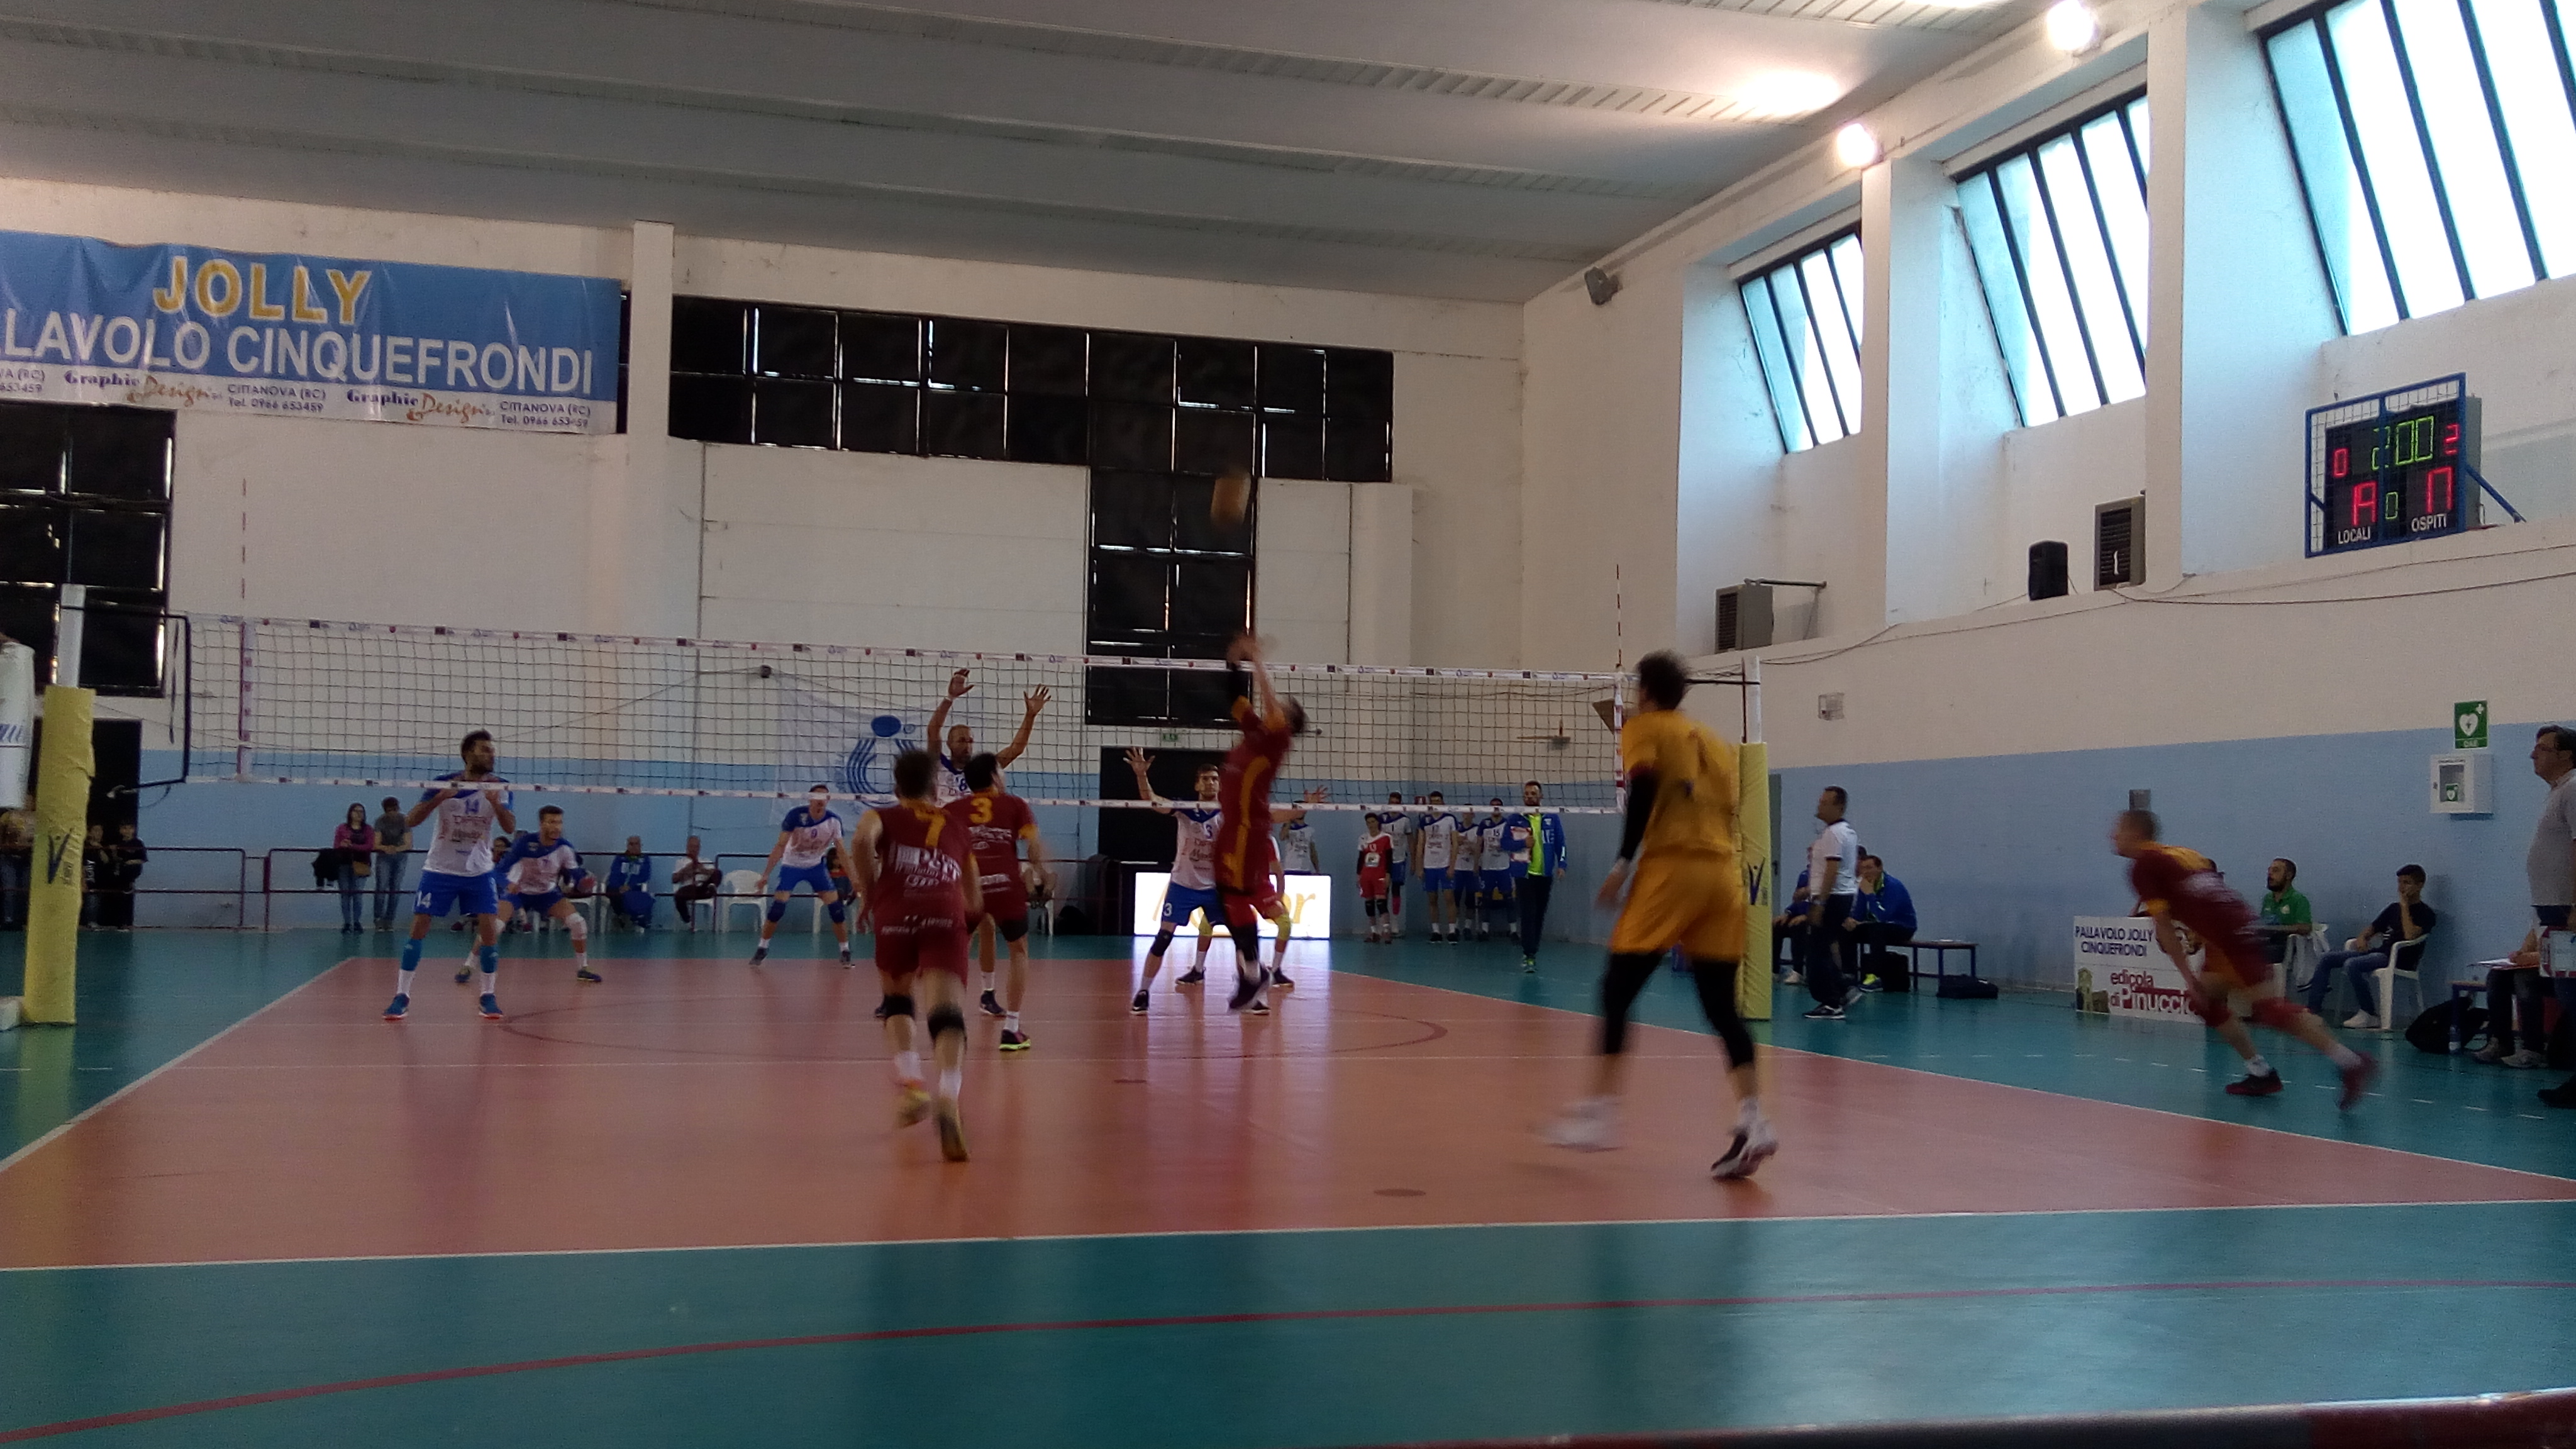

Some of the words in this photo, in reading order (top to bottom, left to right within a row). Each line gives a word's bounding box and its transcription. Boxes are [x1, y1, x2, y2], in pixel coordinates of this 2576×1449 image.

[153, 255, 372, 325] JOLLY
[0, 308, 211, 370] LAVOLO
[227, 326, 592, 394] CINQUEFRONDI
[64, 369, 140, 389] Graphic
[228, 384, 297, 397] CITTANOVA
[347, 389, 418, 406] Graphic
[422, 391, 484, 424] Design
[500, 401, 565, 414] CITTANOVA
[2333, 447, 2351, 479] 0
[2385, 491, 2399, 520] 0
[2411, 513, 2448, 533] OSPITI
[2337, 526, 2371, 545] LOCALI
[969, 797, 993, 824] 3
[915, 808, 947, 847] 7
[416, 890, 432, 909] 14
[1163, 902, 1173, 917] 3
[2075, 925, 2126, 941] PALLAVOLO
[2127, 927, 2154, 942] JOLLY
[2080, 941, 2147, 957] CINQUEFRONDI
[2110, 969, 2154, 988] edicola
